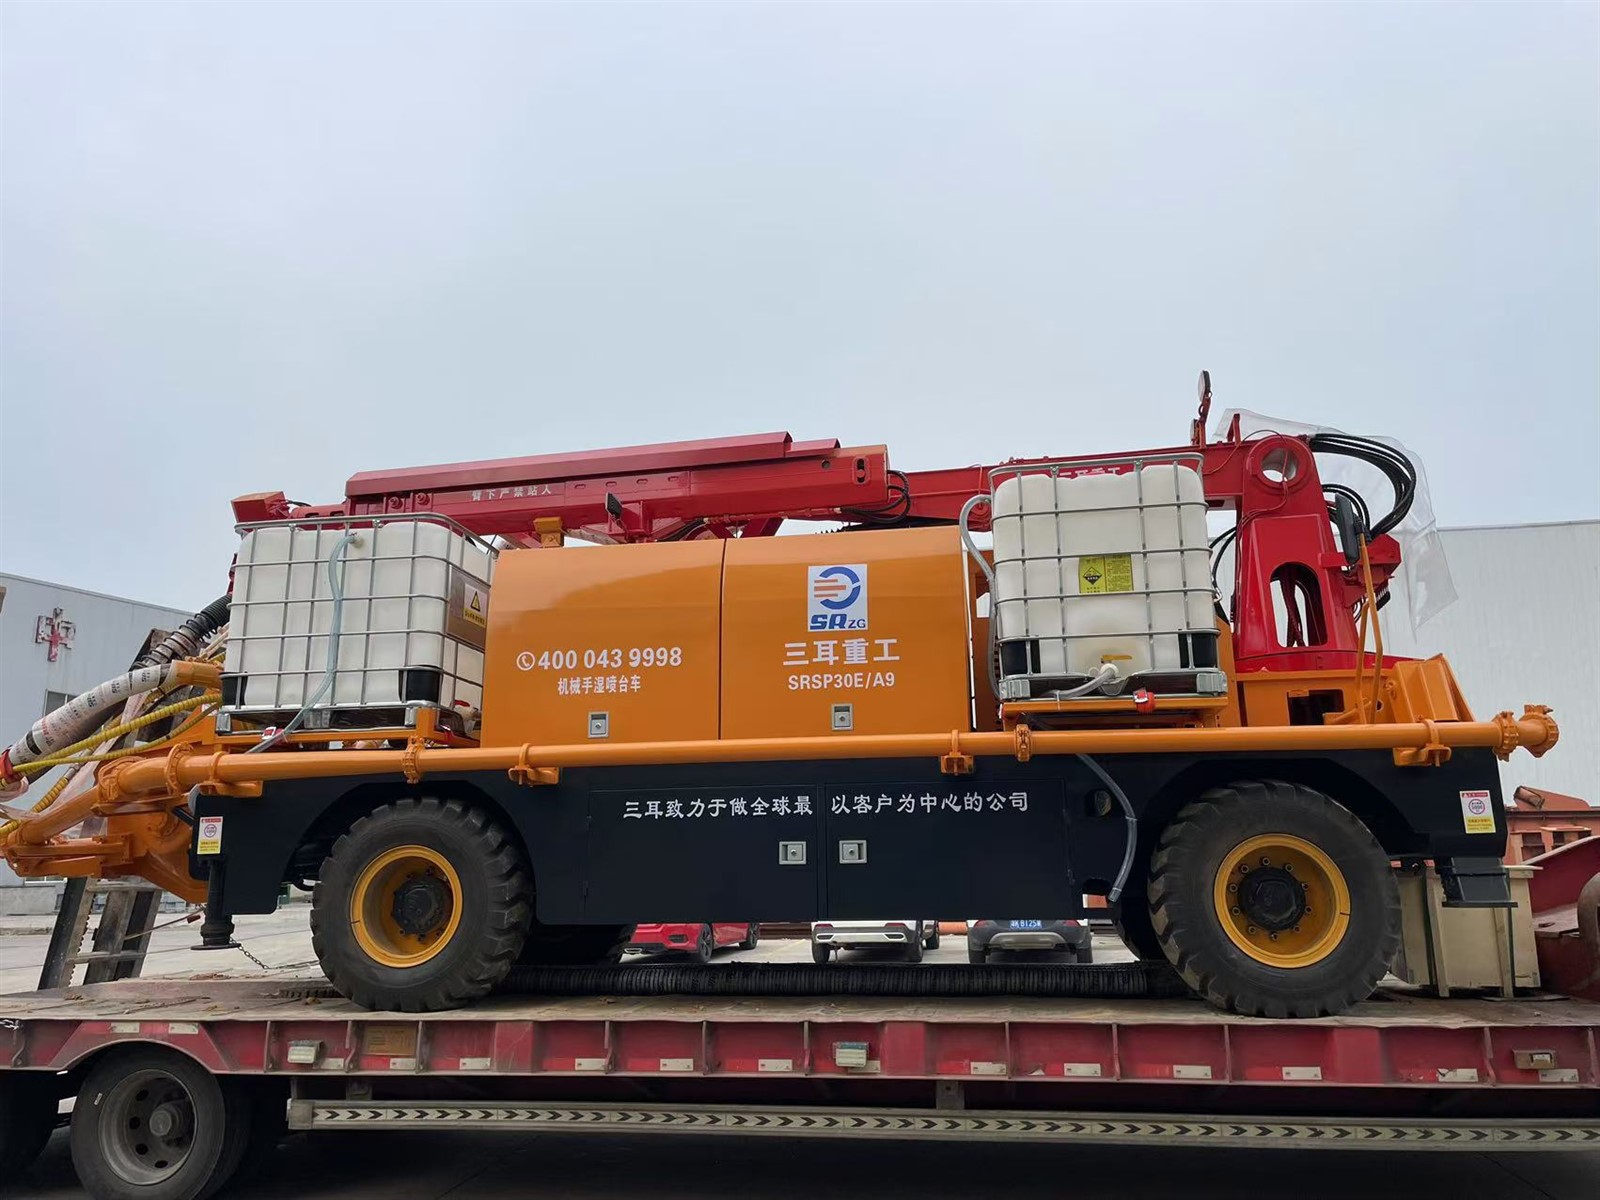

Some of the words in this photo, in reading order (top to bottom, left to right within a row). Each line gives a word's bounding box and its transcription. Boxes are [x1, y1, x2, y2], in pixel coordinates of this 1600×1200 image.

[472, 485, 551, 501] 臂下严禁站人
[538, 651, 577, 669] 400
[584, 649, 623, 668] 043
[629, 647, 682, 667] 9998
[783, 638, 900, 665] 三耳重工
[558, 674, 641, 695] 机械手湿喷台车
[788, 672, 895, 690] SRSP30E/A9
[623, 796, 813, 819] 三耳致力于做全球最
[831, 792, 1028, 814] 以客户为中心的公司
